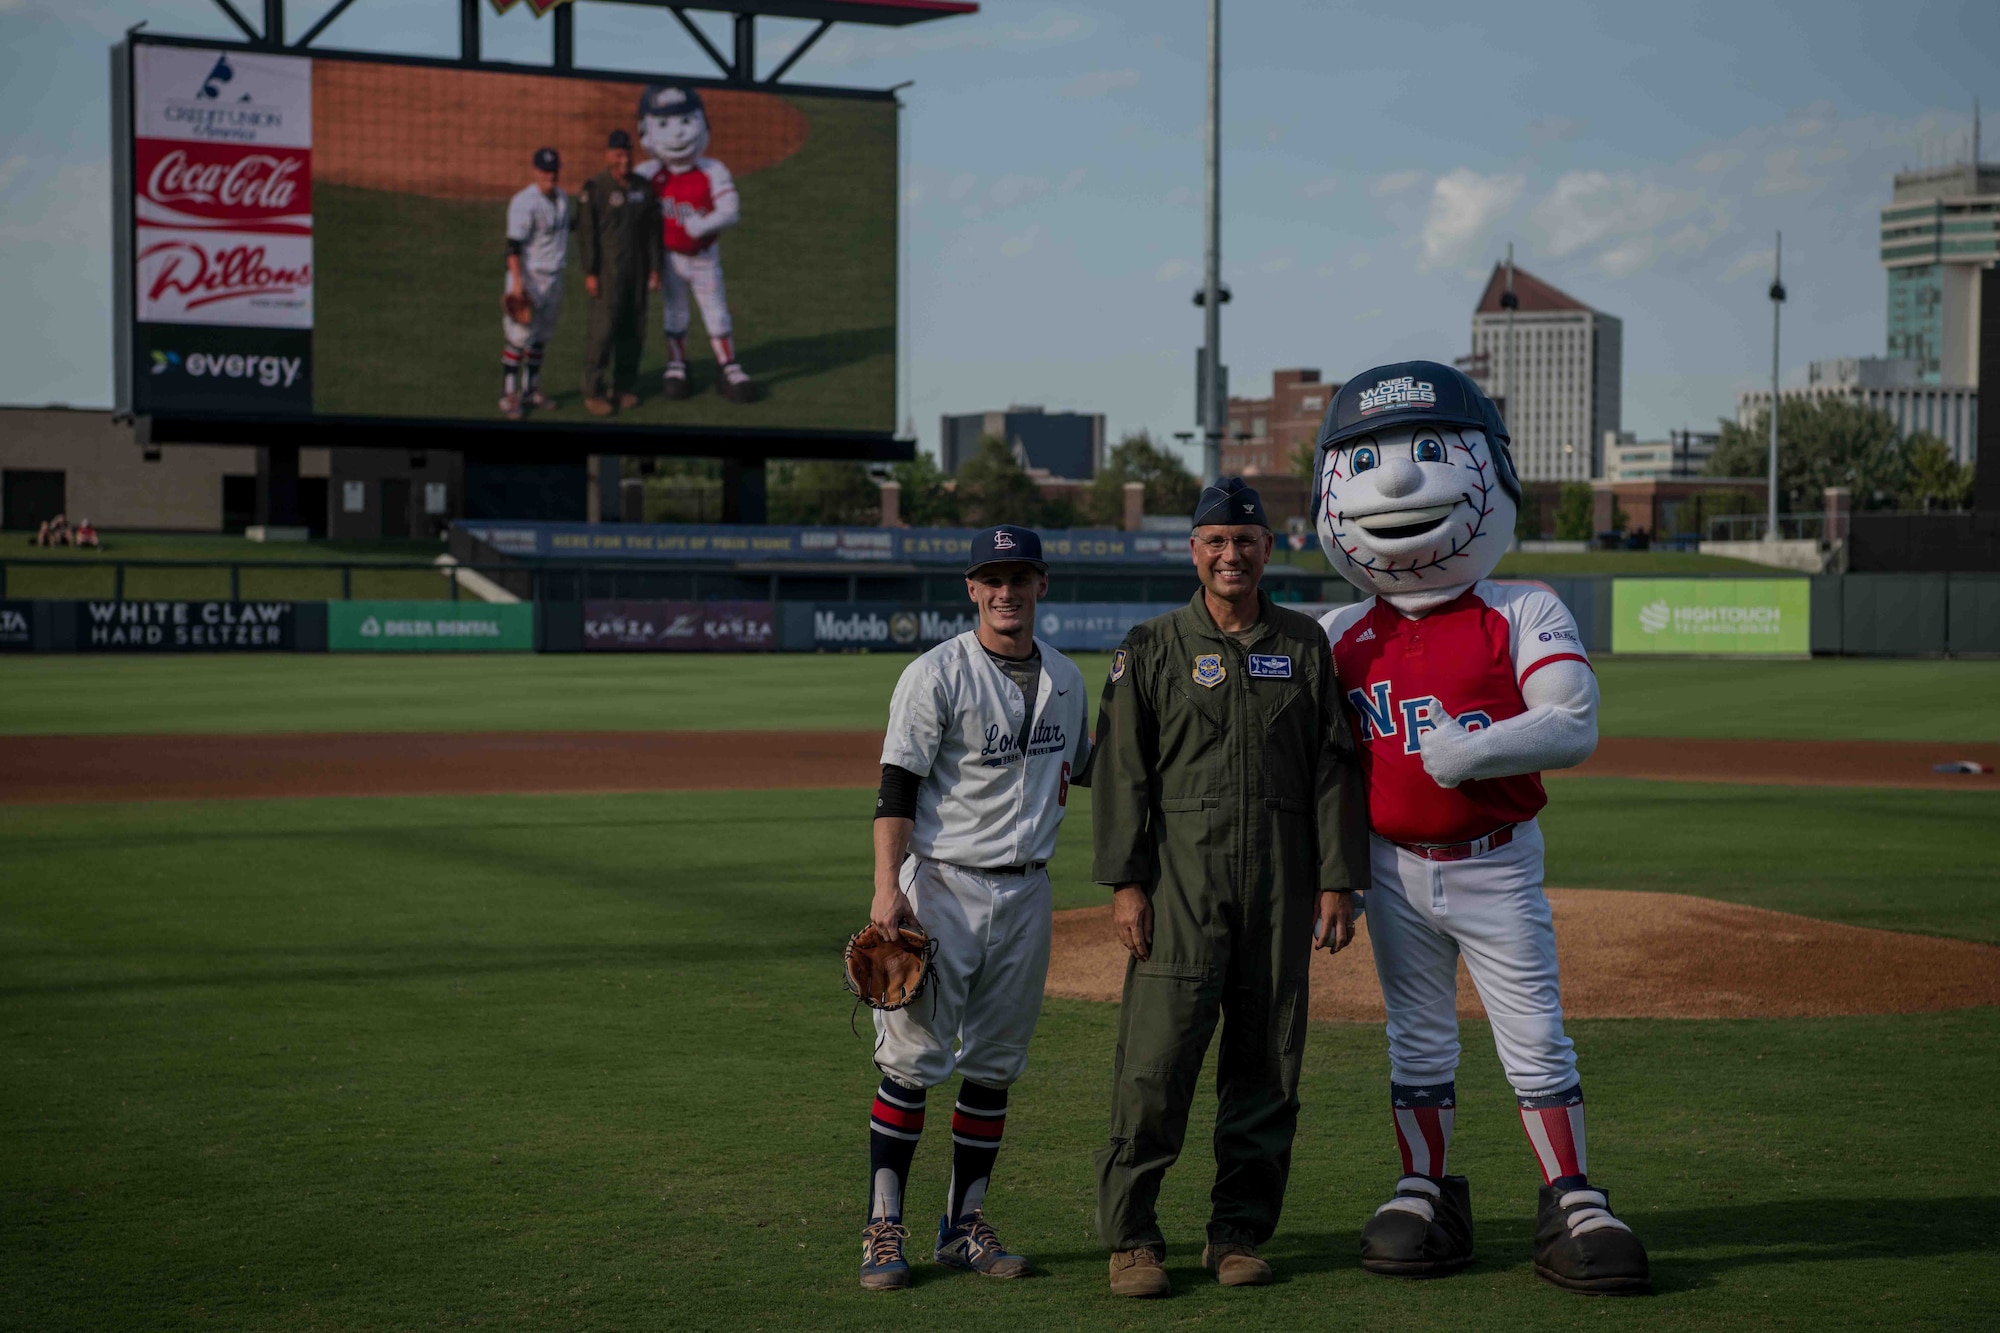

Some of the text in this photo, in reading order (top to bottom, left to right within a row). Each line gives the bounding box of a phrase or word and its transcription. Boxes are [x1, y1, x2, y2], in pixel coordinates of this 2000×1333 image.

[147, 149, 304, 209] Coca-Cola
[138, 242, 310, 301] Dillons
[185, 352, 302, 388] evergy
[1359, 381, 1435, 400] WORLD
[1377, 376, 1415, 389] NBC
[1360, 390, 1437, 412] SERIES
[89, 602, 282, 624] WHITE CLAW
[1674, 607, 1780, 622] HIGHTOUCH
[92, 625, 281, 645] HARD SELTZER
[814, 611, 888, 641] Modelo
[1058, 761, 1071, 807] 6
